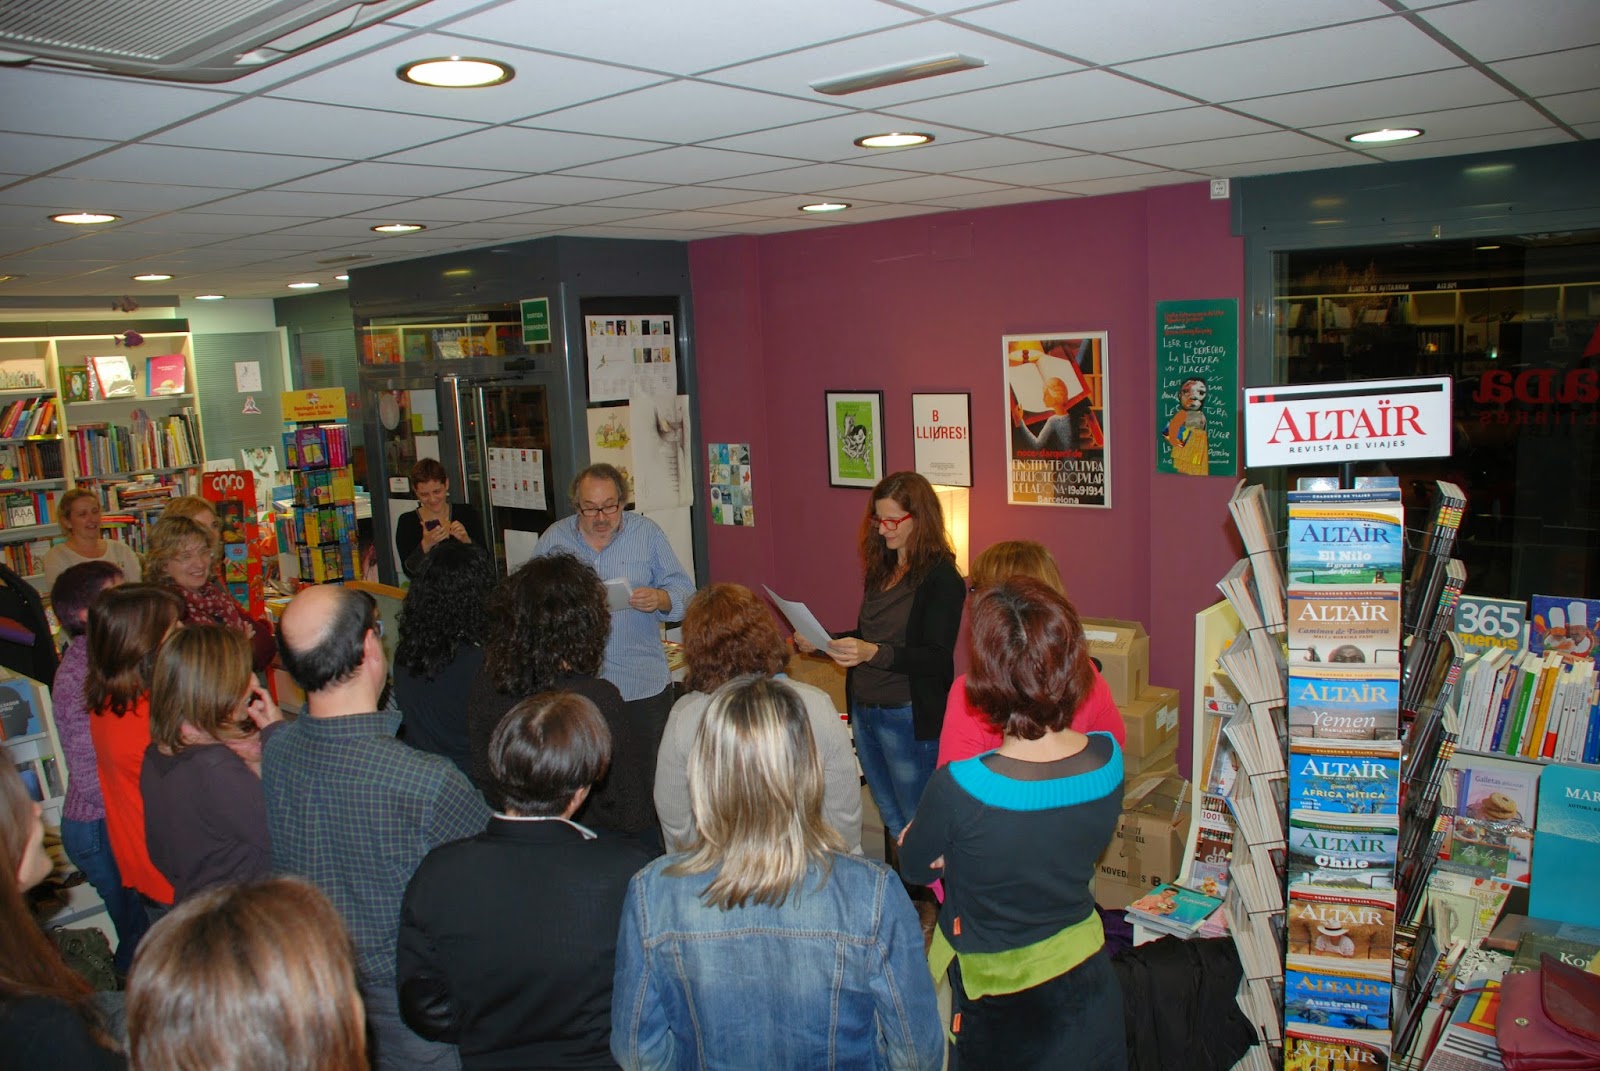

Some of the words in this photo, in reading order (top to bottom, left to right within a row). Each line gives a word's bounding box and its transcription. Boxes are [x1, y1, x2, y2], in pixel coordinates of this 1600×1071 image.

[1163, 337, 1181, 347] LEER
[1183, 353, 1219, 364] LECTURA
[932, 410, 939, 422] B
[1267, 400, 1428, 444] ALTAÏR
[1289, 444, 1339, 453] REVISTA
[1366, 440, 1405, 448] VIAJES
[1037, 495, 1079, 504] Barcelona
[1299, 523, 1391, 543] ALTAÏR
[1318, 550, 1336, 560] El
[1339, 550, 1372, 560] Nilo
[1297, 602, 1389, 621] ALTAÏR
[1458, 603, 1520, 638] 365
[1299, 683, 1389, 702] ALTAÏR
[1312, 711, 1376, 728] Yemen
[1300, 759, 1389, 779] ALTAÏR
[1474, 776, 1500, 785] Galletas
[1302, 788, 1342, 798] ÁFRICA
[1346, 790, 1385, 799] MÍTICA
[1568, 803, 1591, 811] AUTORA
[1203, 812, 1220, 821] 1001
[1300, 832, 1386, 853] ALTAÏR
[1213, 847, 1225, 858] LA
[1314, 855, 1369, 868] Chile
[1298, 904, 1384, 926] ALTAÏR
[1295, 976, 1381, 996] ALTAÏR
[1305, 999, 1368, 1010] Australia
[1293, 1042, 1378, 1065] ALTAÏR
